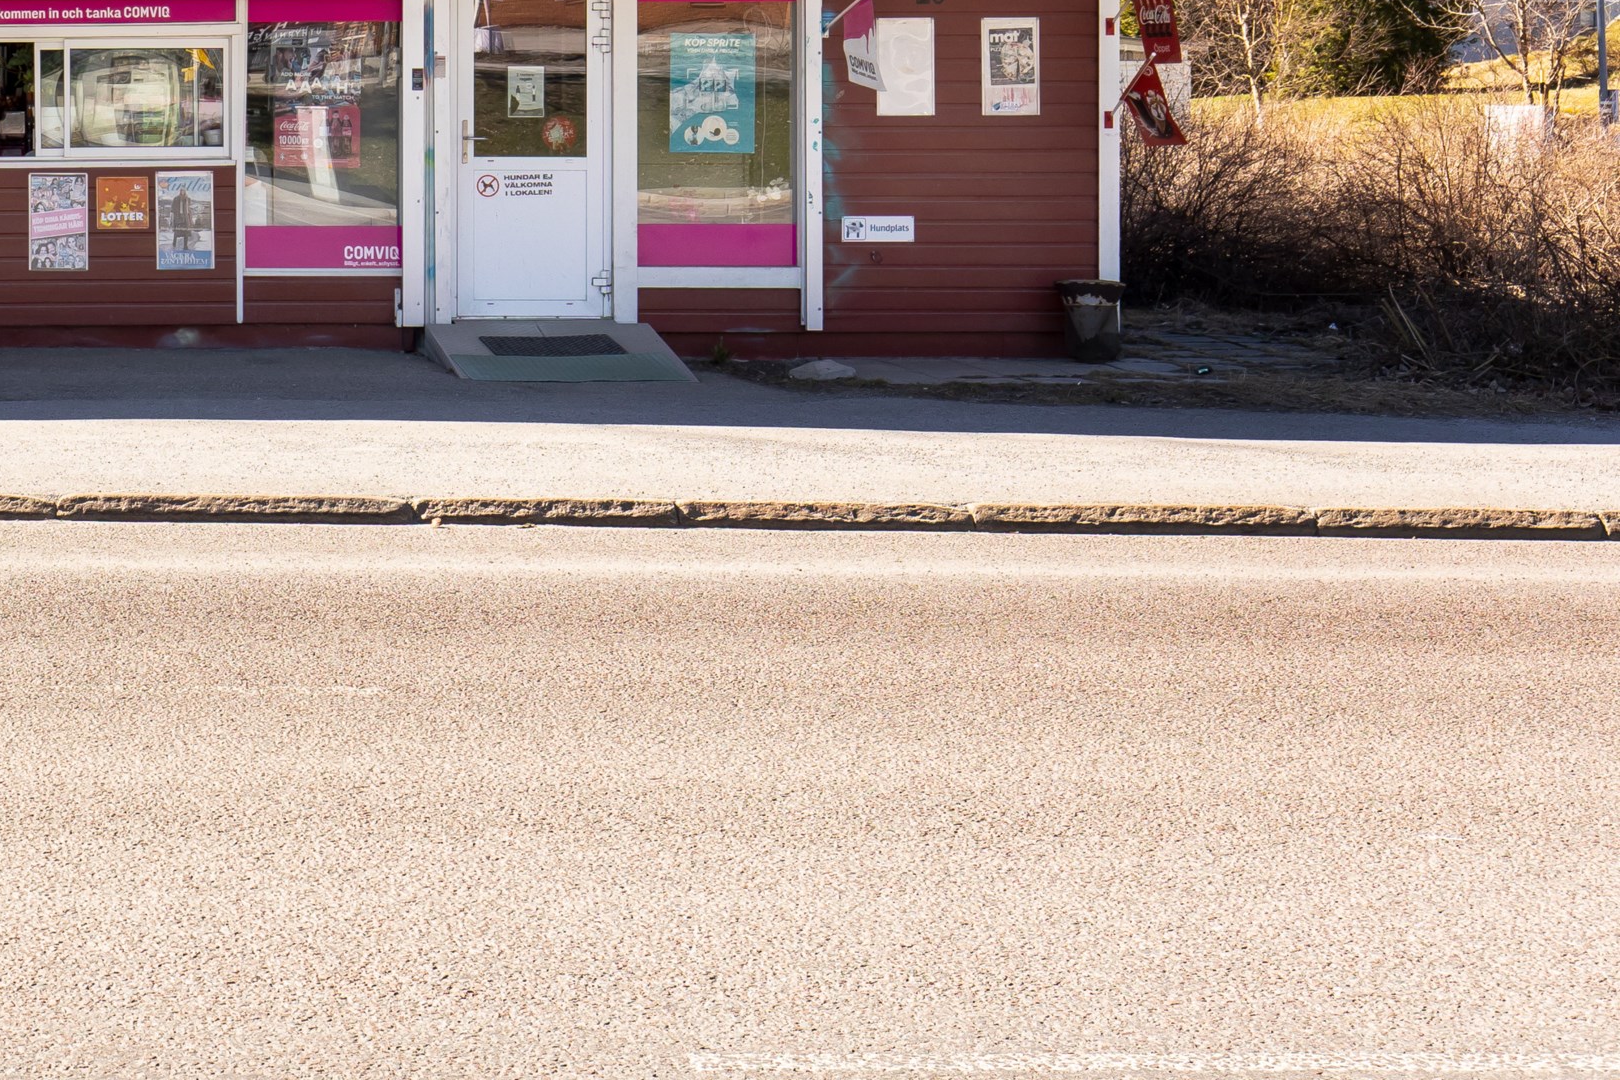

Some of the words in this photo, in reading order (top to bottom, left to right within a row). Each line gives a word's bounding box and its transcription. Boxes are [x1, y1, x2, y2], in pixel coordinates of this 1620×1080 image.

[48, 8, 59, 19] in
[62, 8, 82, 18] och
[86, 7, 122, 18] tanka
[124, 6, 170, 18] COMVIQ
[707, 38, 740, 47] SPRITE
[990, 30, 1020, 43] mat
[849, 55, 876, 74] COMVIQ
[101, 212, 143, 222] LOTTER
[870, 224, 909, 233] Hundplats
[344, 246, 400, 260] COMVIQ
